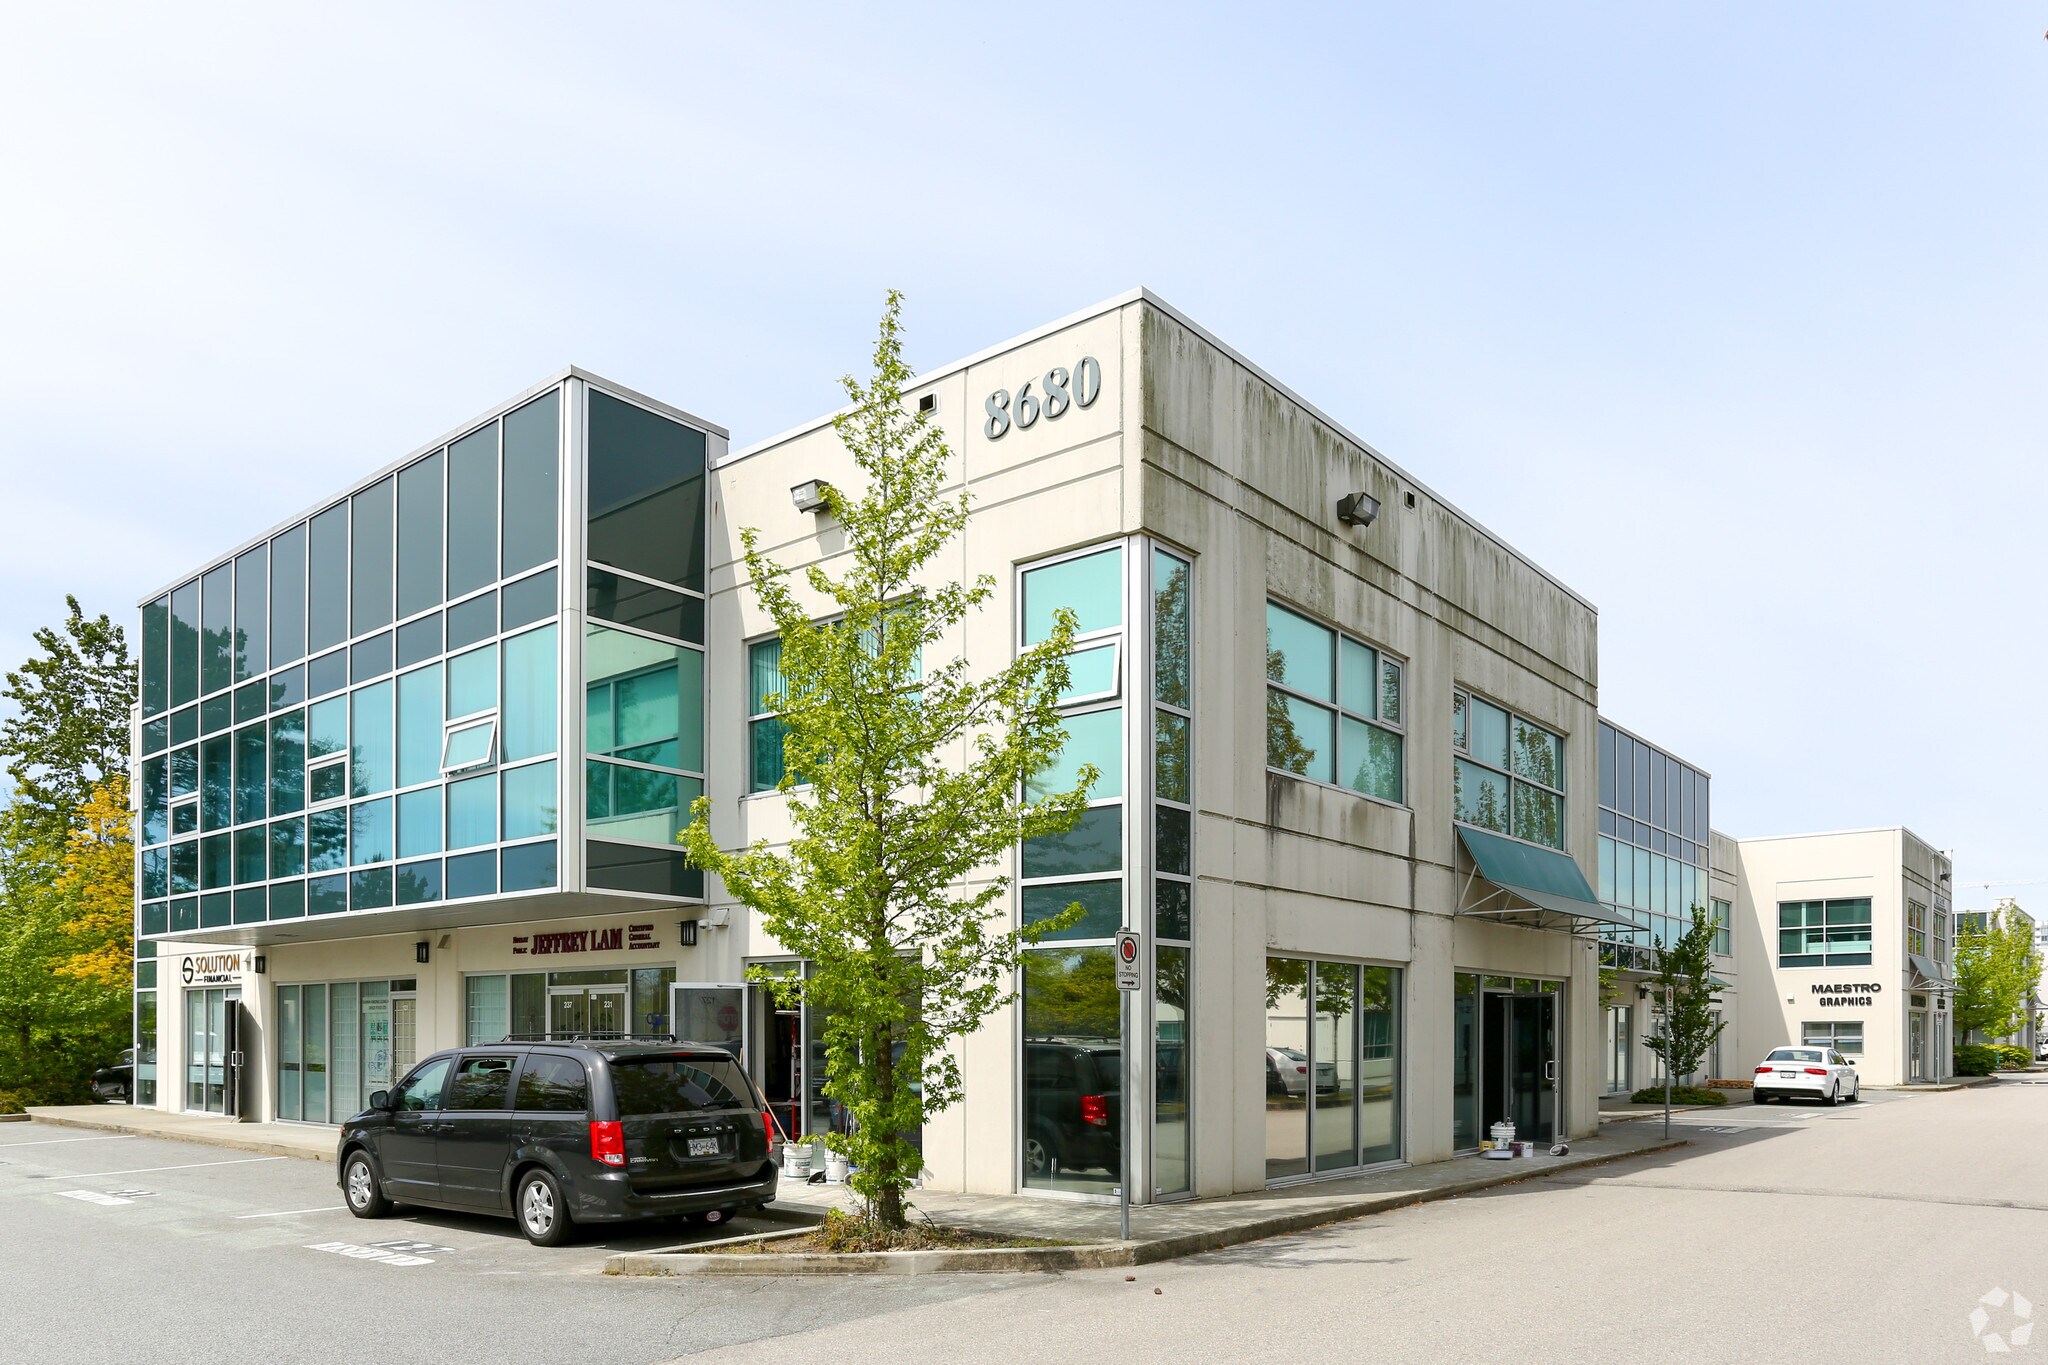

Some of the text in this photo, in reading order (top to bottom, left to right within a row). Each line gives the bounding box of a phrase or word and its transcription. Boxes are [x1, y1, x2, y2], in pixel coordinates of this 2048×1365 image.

[984, 356, 1101, 440] 8680
[531, 928, 623, 955] JEFFREY LAM
[628, 941, 660, 950] ACCOUNTANT
[195, 954, 240, 974] SOLUTION
[204, 974, 232, 983] FINANCIAL
[1811, 983, 1882, 994] MAESTRO
[1820, 996, 1873, 1007] GRAPHICS
[674, 1125, 733, 1134] DODGE
